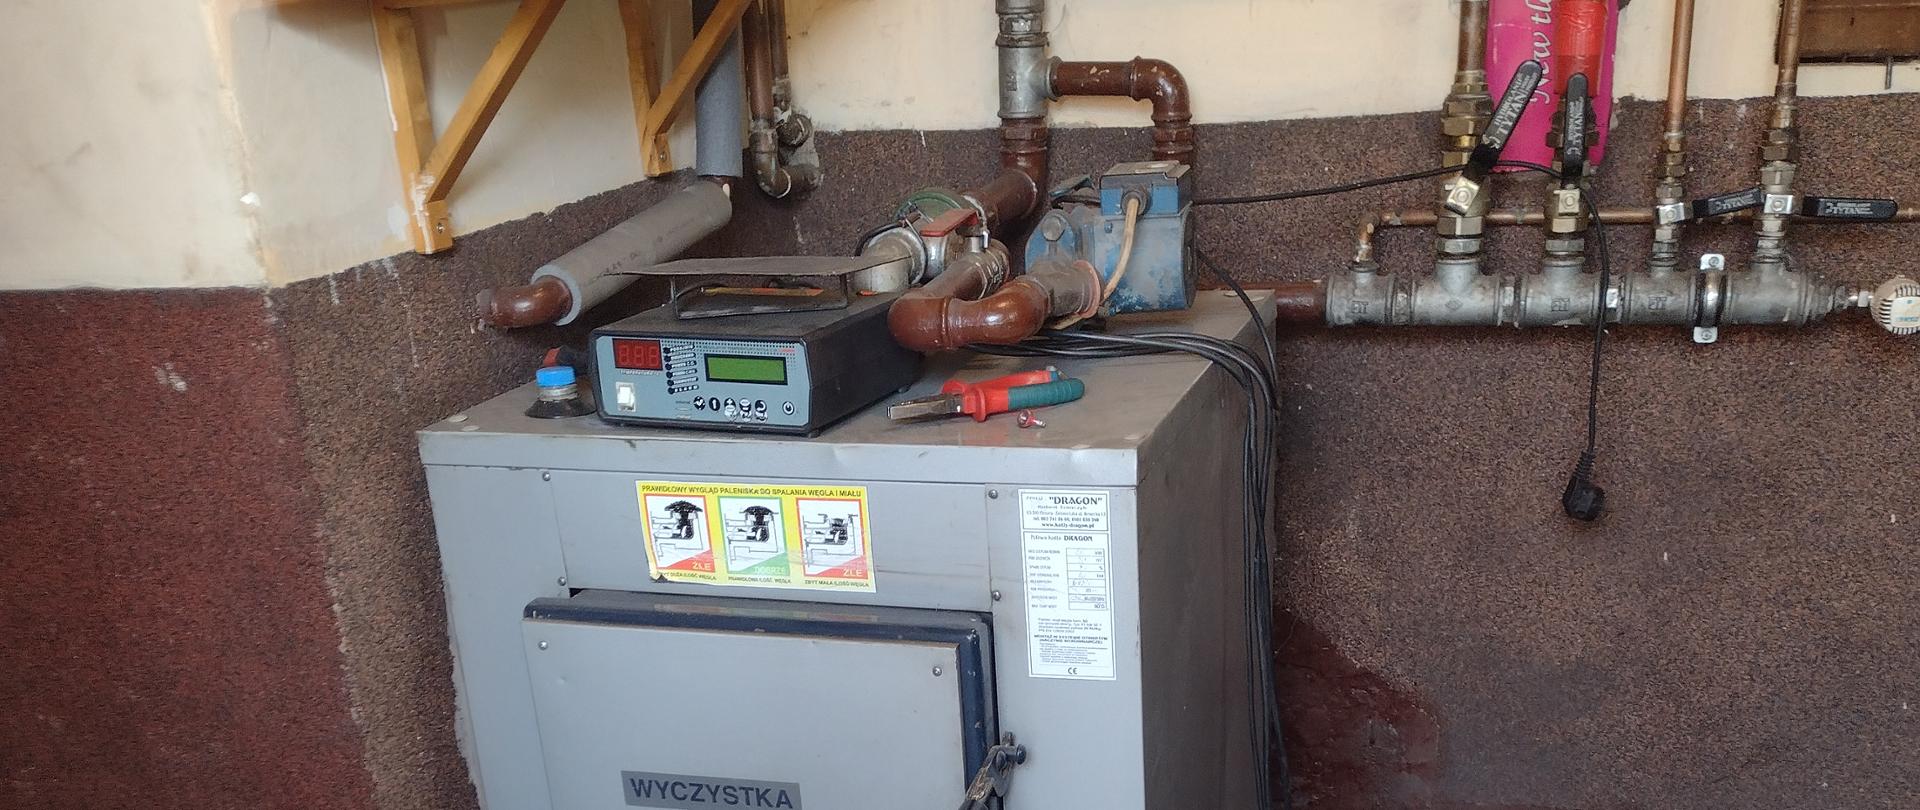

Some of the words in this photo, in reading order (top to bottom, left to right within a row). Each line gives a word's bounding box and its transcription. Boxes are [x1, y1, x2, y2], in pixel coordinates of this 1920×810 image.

[1499, 85, 1526, 134] TYTAN
[1573, 112, 1584, 145] TYTAN
[641, 485, 688, 494] PRAWIDŁOWY
[688, 486, 719, 495] WYGLĄD
[719, 487, 760, 495] PALENISKA
[760, 488, 771, 496] DO
[771, 488, 807, 497] SPALANIA
[807, 489, 834, 498] WĘGLA
[839, 490, 862, 498] MIAŁU
[1049, 496, 1103, 505] "DRAGON"
[691, 560, 712, 571] ŹLE
[842, 566, 863, 577] ŹLE
[629, 778, 794, 809] WYCZYSTKA
